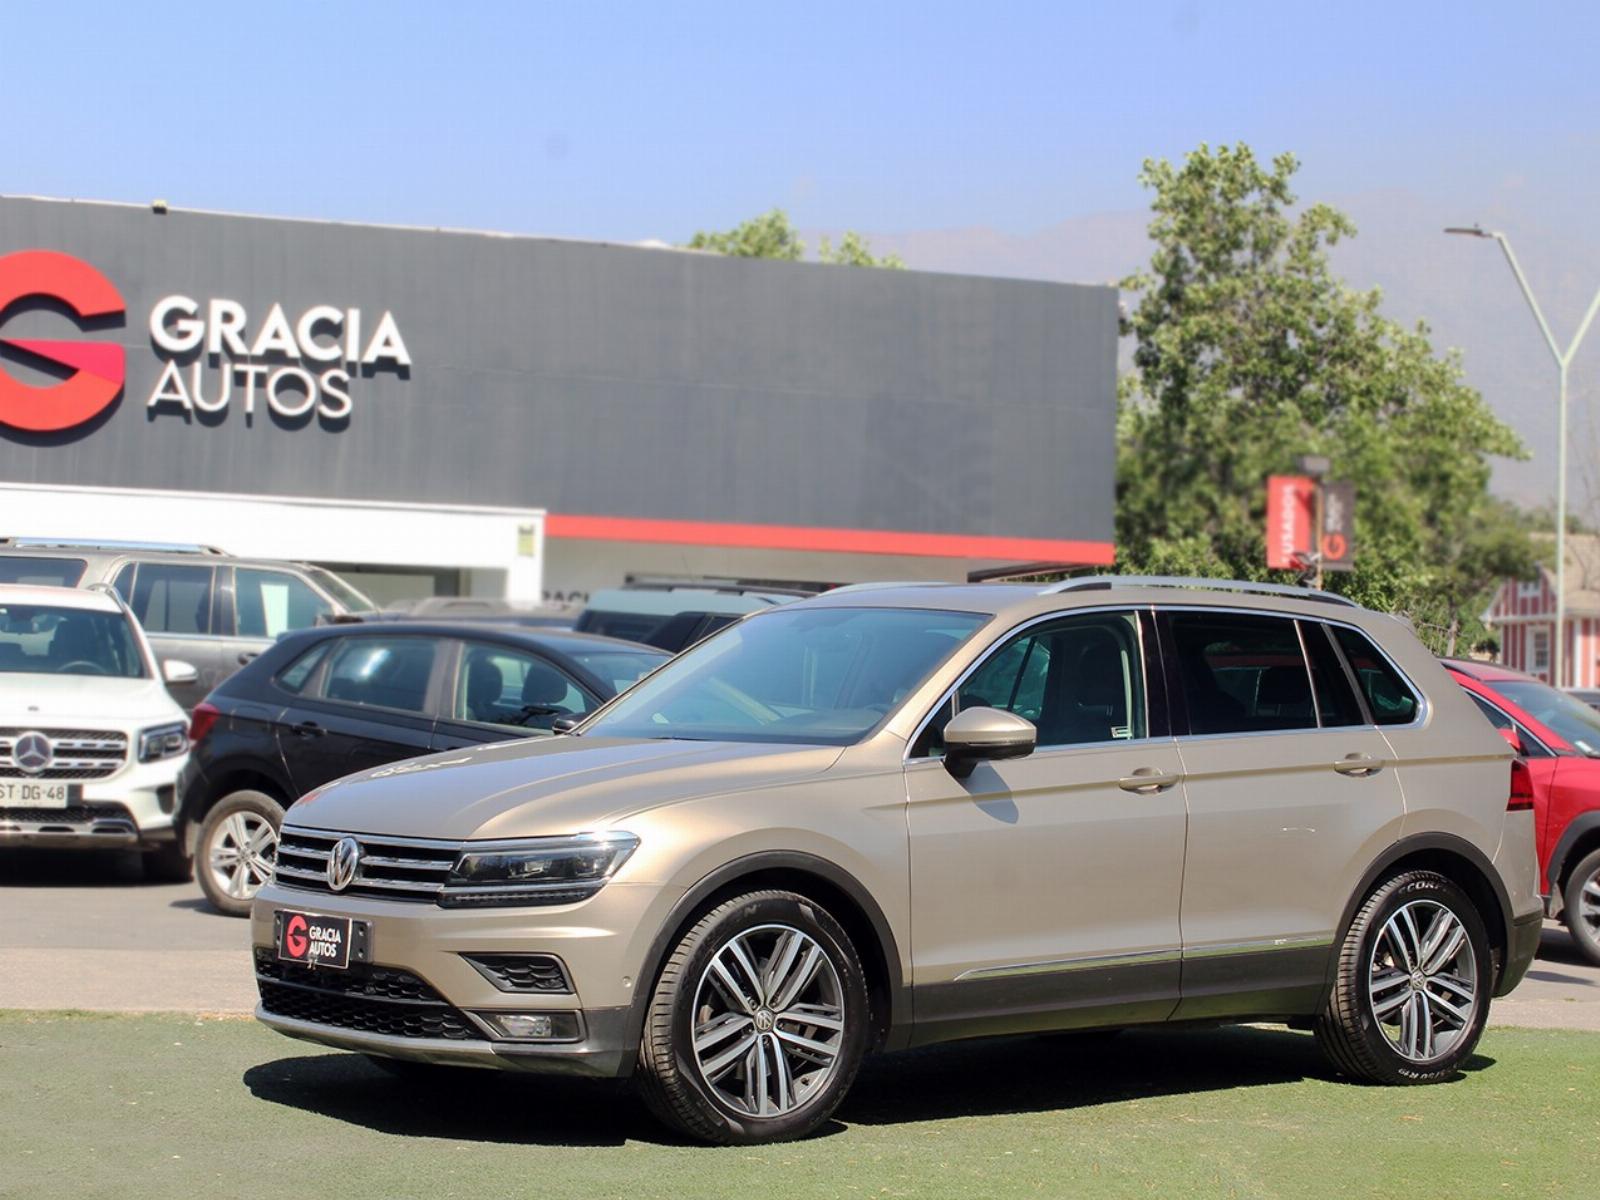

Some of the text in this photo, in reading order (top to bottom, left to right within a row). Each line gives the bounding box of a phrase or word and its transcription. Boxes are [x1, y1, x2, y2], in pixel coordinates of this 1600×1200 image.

[149, 295, 411, 366] GRACIA
[147, 359, 353, 419] AUTOS
[308, 941, 337, 957] AUTOS
[309, 926, 342, 943] GRACIA
